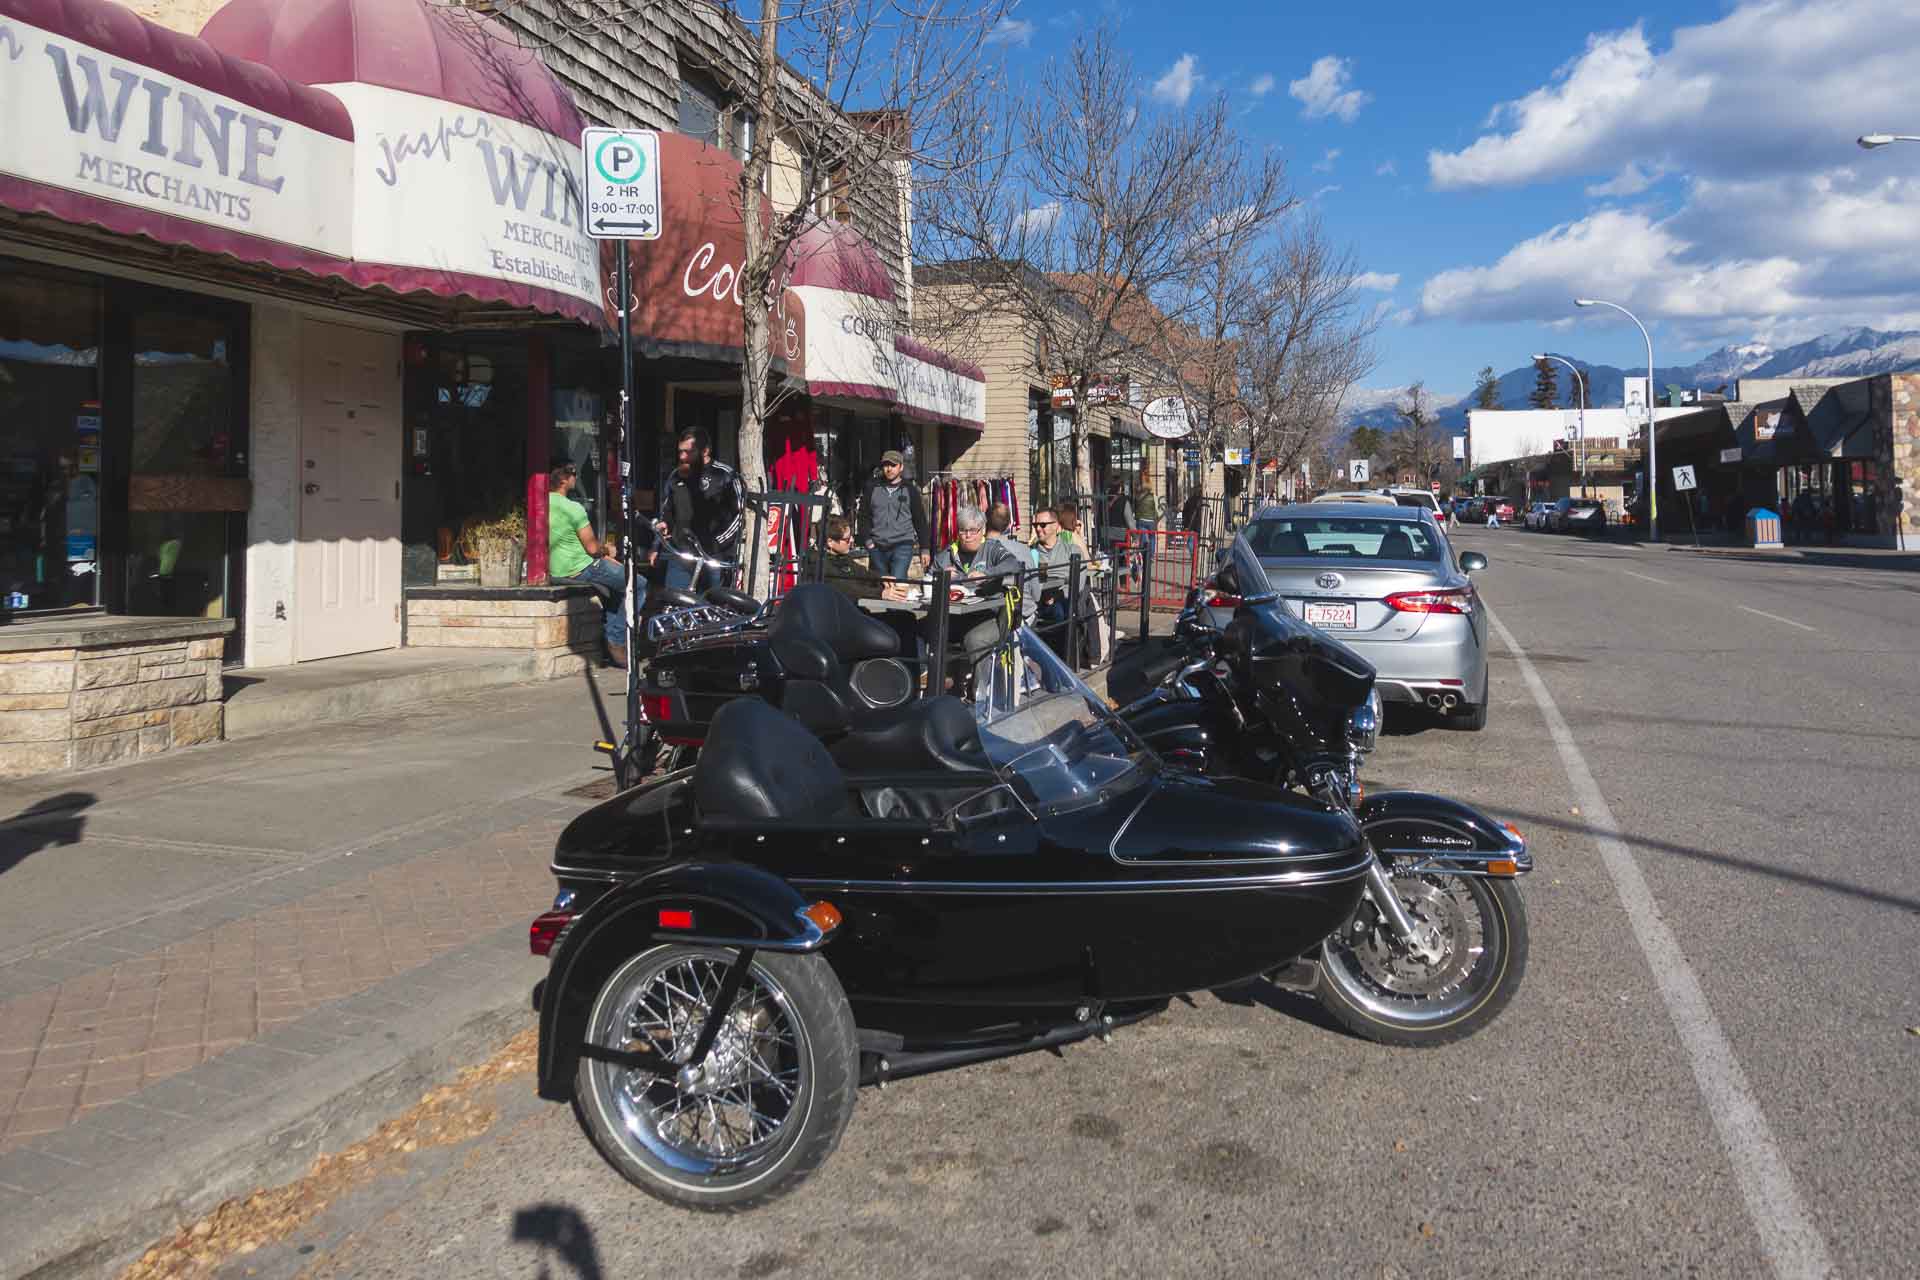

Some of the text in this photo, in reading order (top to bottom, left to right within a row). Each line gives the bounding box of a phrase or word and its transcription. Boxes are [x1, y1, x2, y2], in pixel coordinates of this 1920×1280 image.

[45, 42, 286, 195] WINE
[77, 151, 252, 222] MERCHANTS
[476, 138, 584, 235] WIN
[613, 146, 634, 172] P
[606, 186, 639, 198] 2 HR
[490, 248, 577, 287] Established
